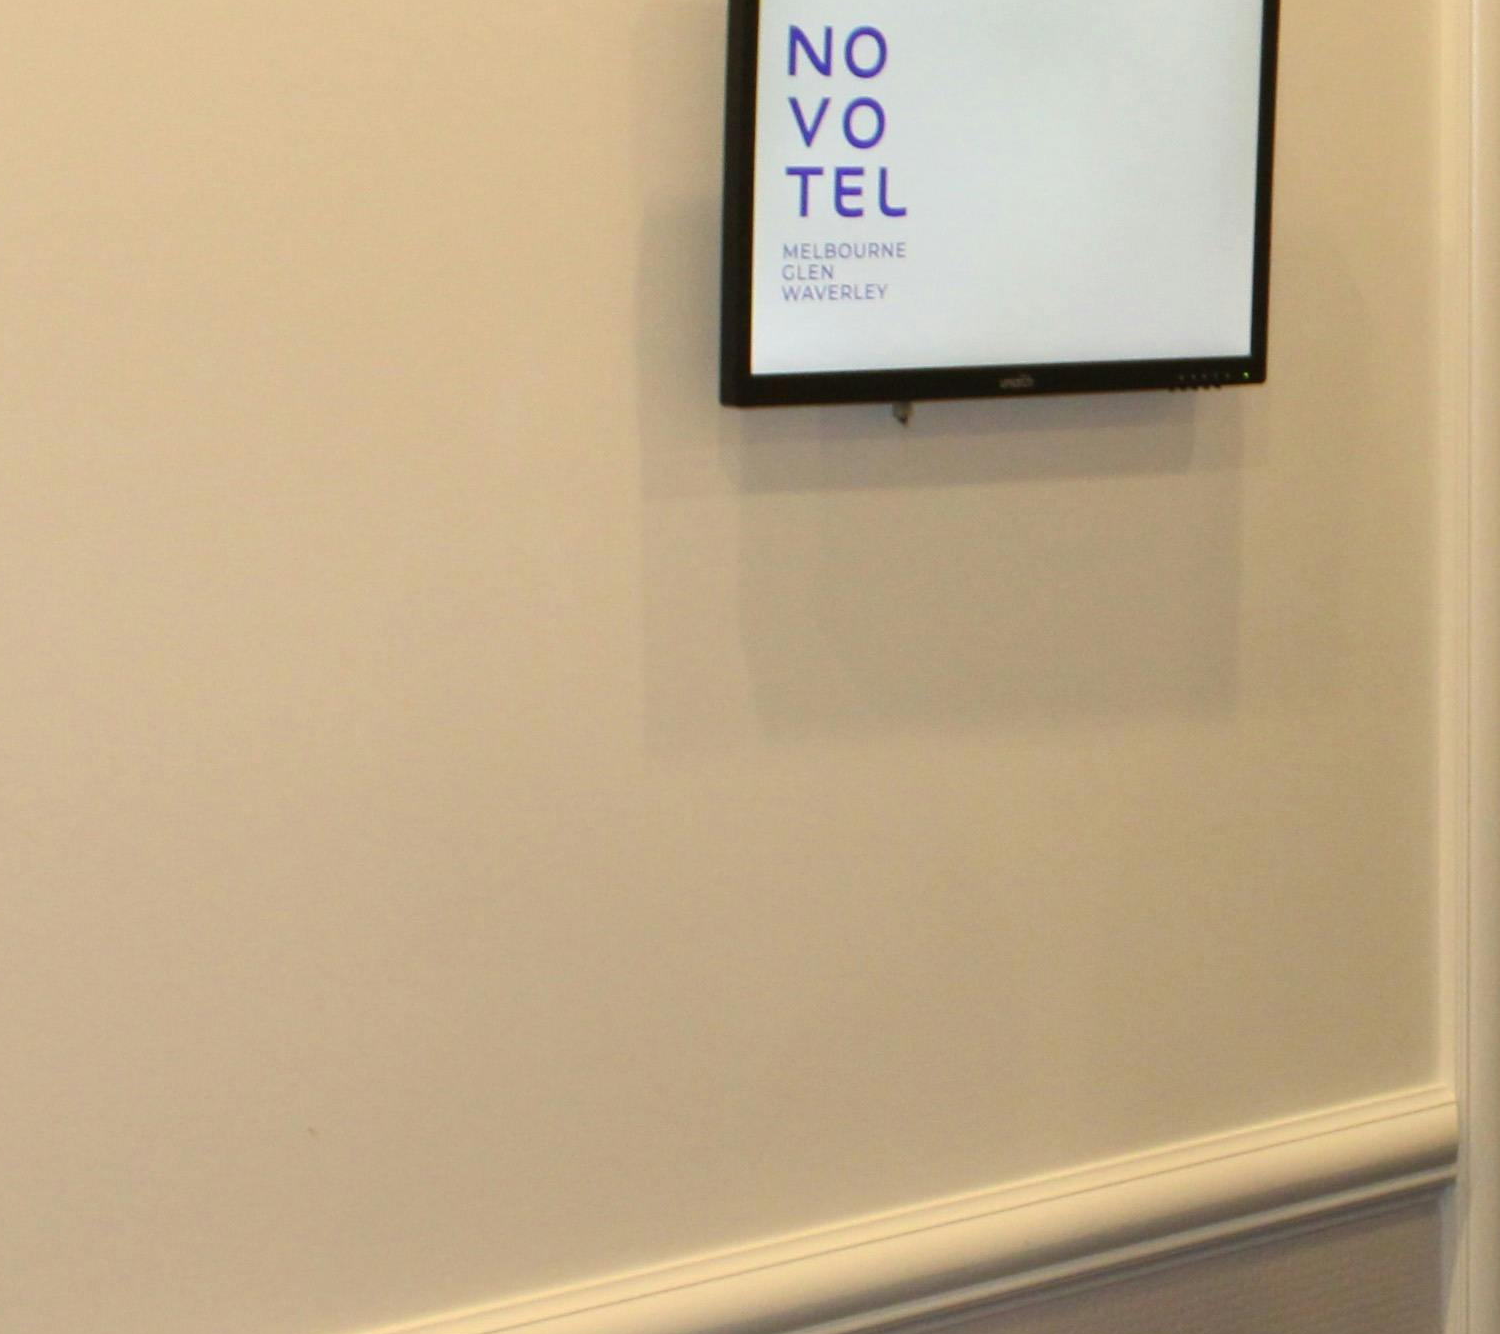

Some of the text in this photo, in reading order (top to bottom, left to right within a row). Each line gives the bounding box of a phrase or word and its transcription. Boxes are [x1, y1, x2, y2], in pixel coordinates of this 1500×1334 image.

[787, 24, 888, 79] NO
[787, 96, 886, 149] VO
[784, 166, 908, 218] TEL
[782, 241, 907, 260] MELBOURNE
[781, 263, 835, 282] GLEN
[781, 283, 889, 302] WAVERLEY
